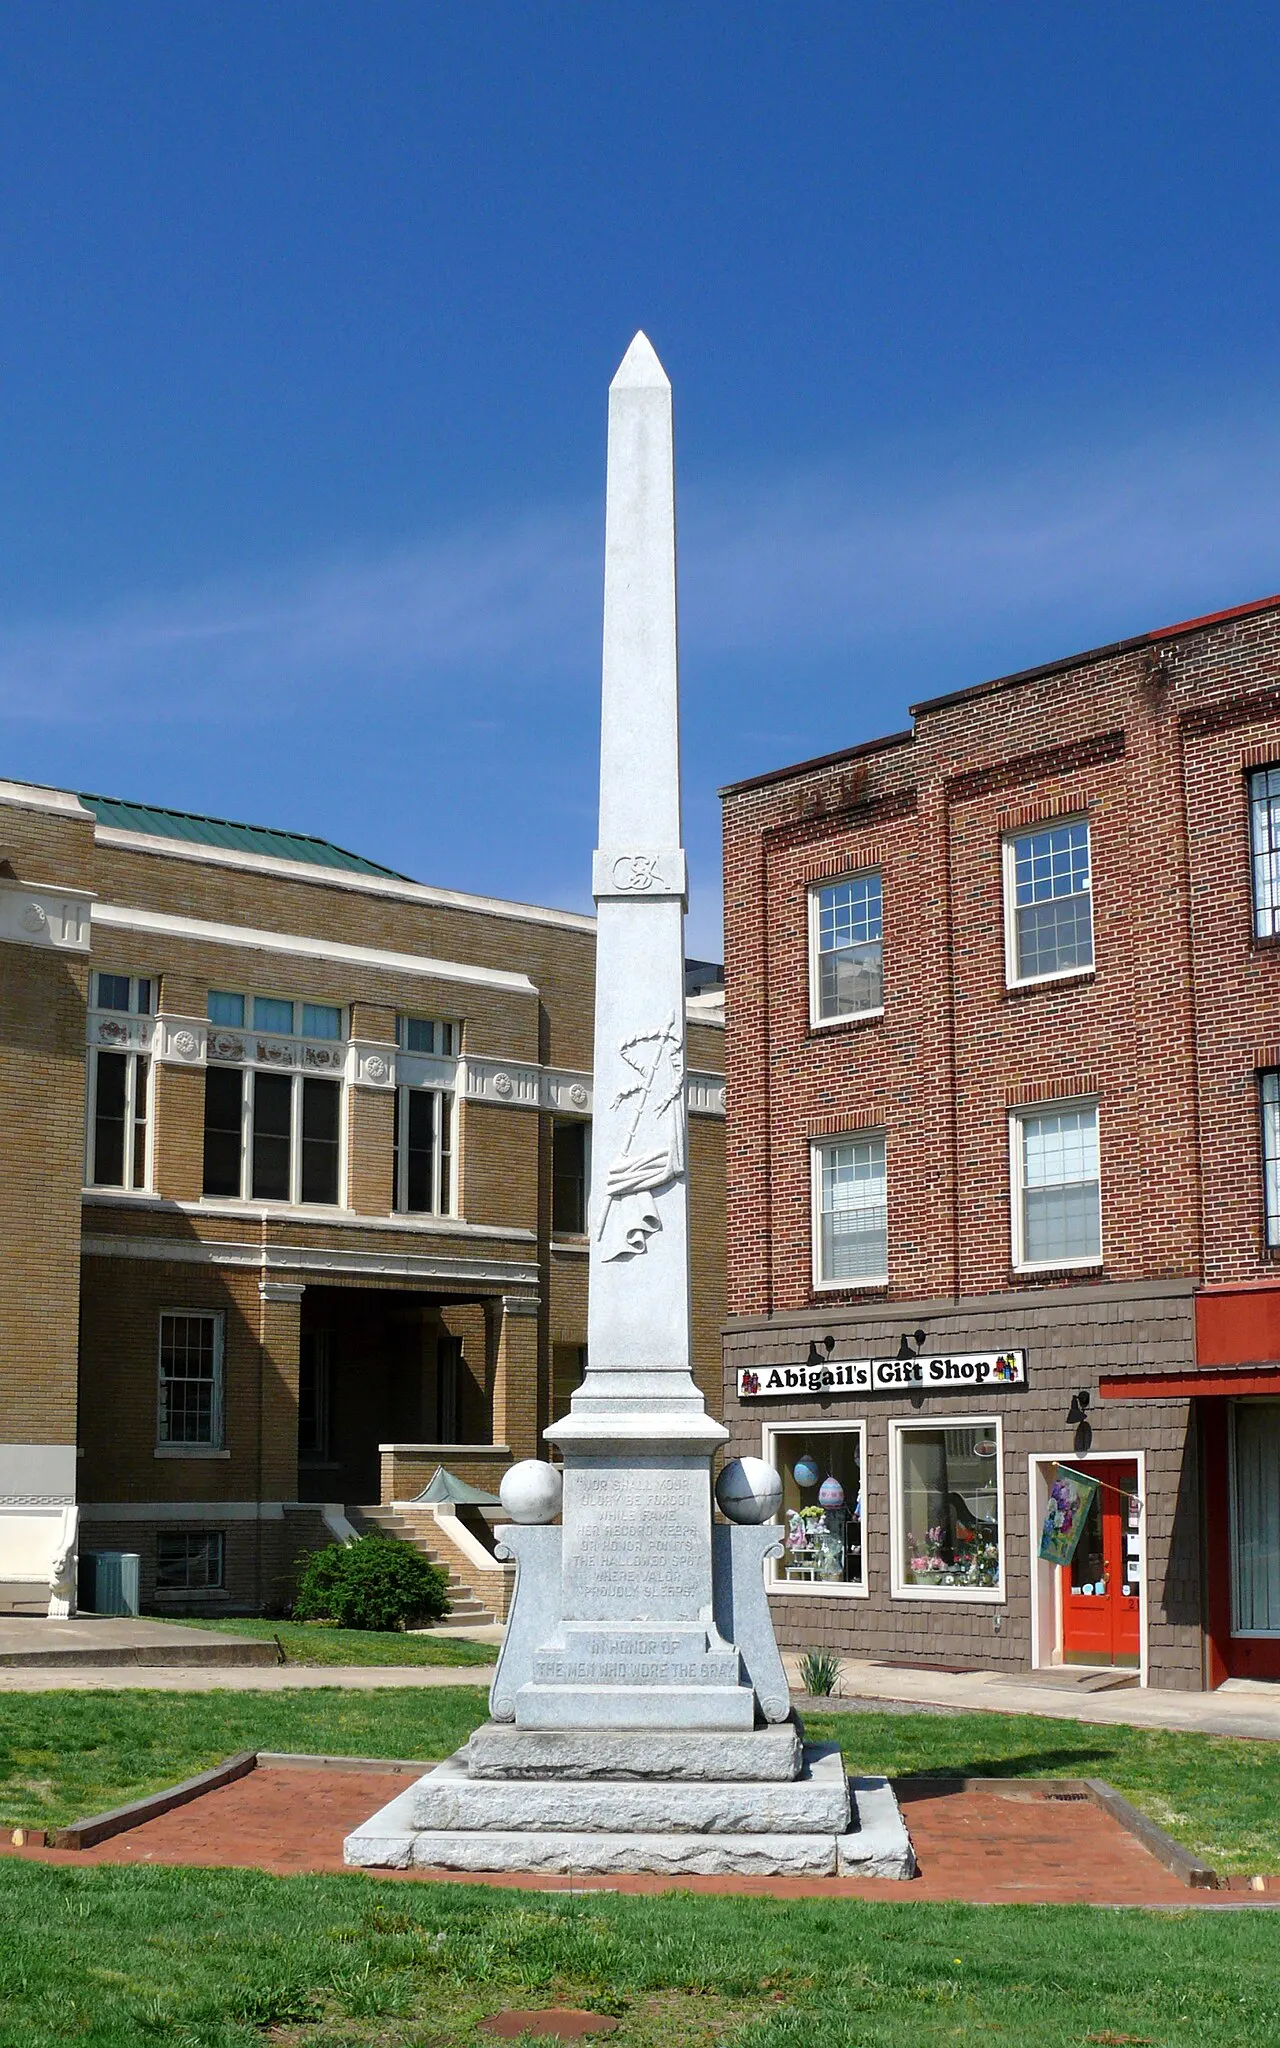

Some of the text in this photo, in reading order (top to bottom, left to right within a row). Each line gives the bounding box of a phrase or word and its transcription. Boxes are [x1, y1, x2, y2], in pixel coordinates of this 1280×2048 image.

[766, 1359, 990, 1391] Abigail's Gift Shop
[612, 1479, 652, 1491] SHALL
[659, 1479, 691, 1491] YOUR
[581, 1494, 692, 1506] GLORY BE FORGOT
[599, 1510, 677, 1521] WHILE FAME
[577, 1525, 697, 1537] HER RECORD KEEPS
[602, 1540, 642, 1552] HONOR
[572, 1555, 595, 1567] THE
[600, 1555, 667, 1567] HALLOWED
[595, 1570, 681, 1582] WHERE VALOR
[591, 1640, 680, 1655] IN HONOR OF
[537, 1662, 564, 1678] THE
[567, 1662, 595, 1678] MEN
[599, 1662, 627, 1678] WHO
[631, 1662, 668, 1678] WORE
[671, 1662, 696, 1678] THE
